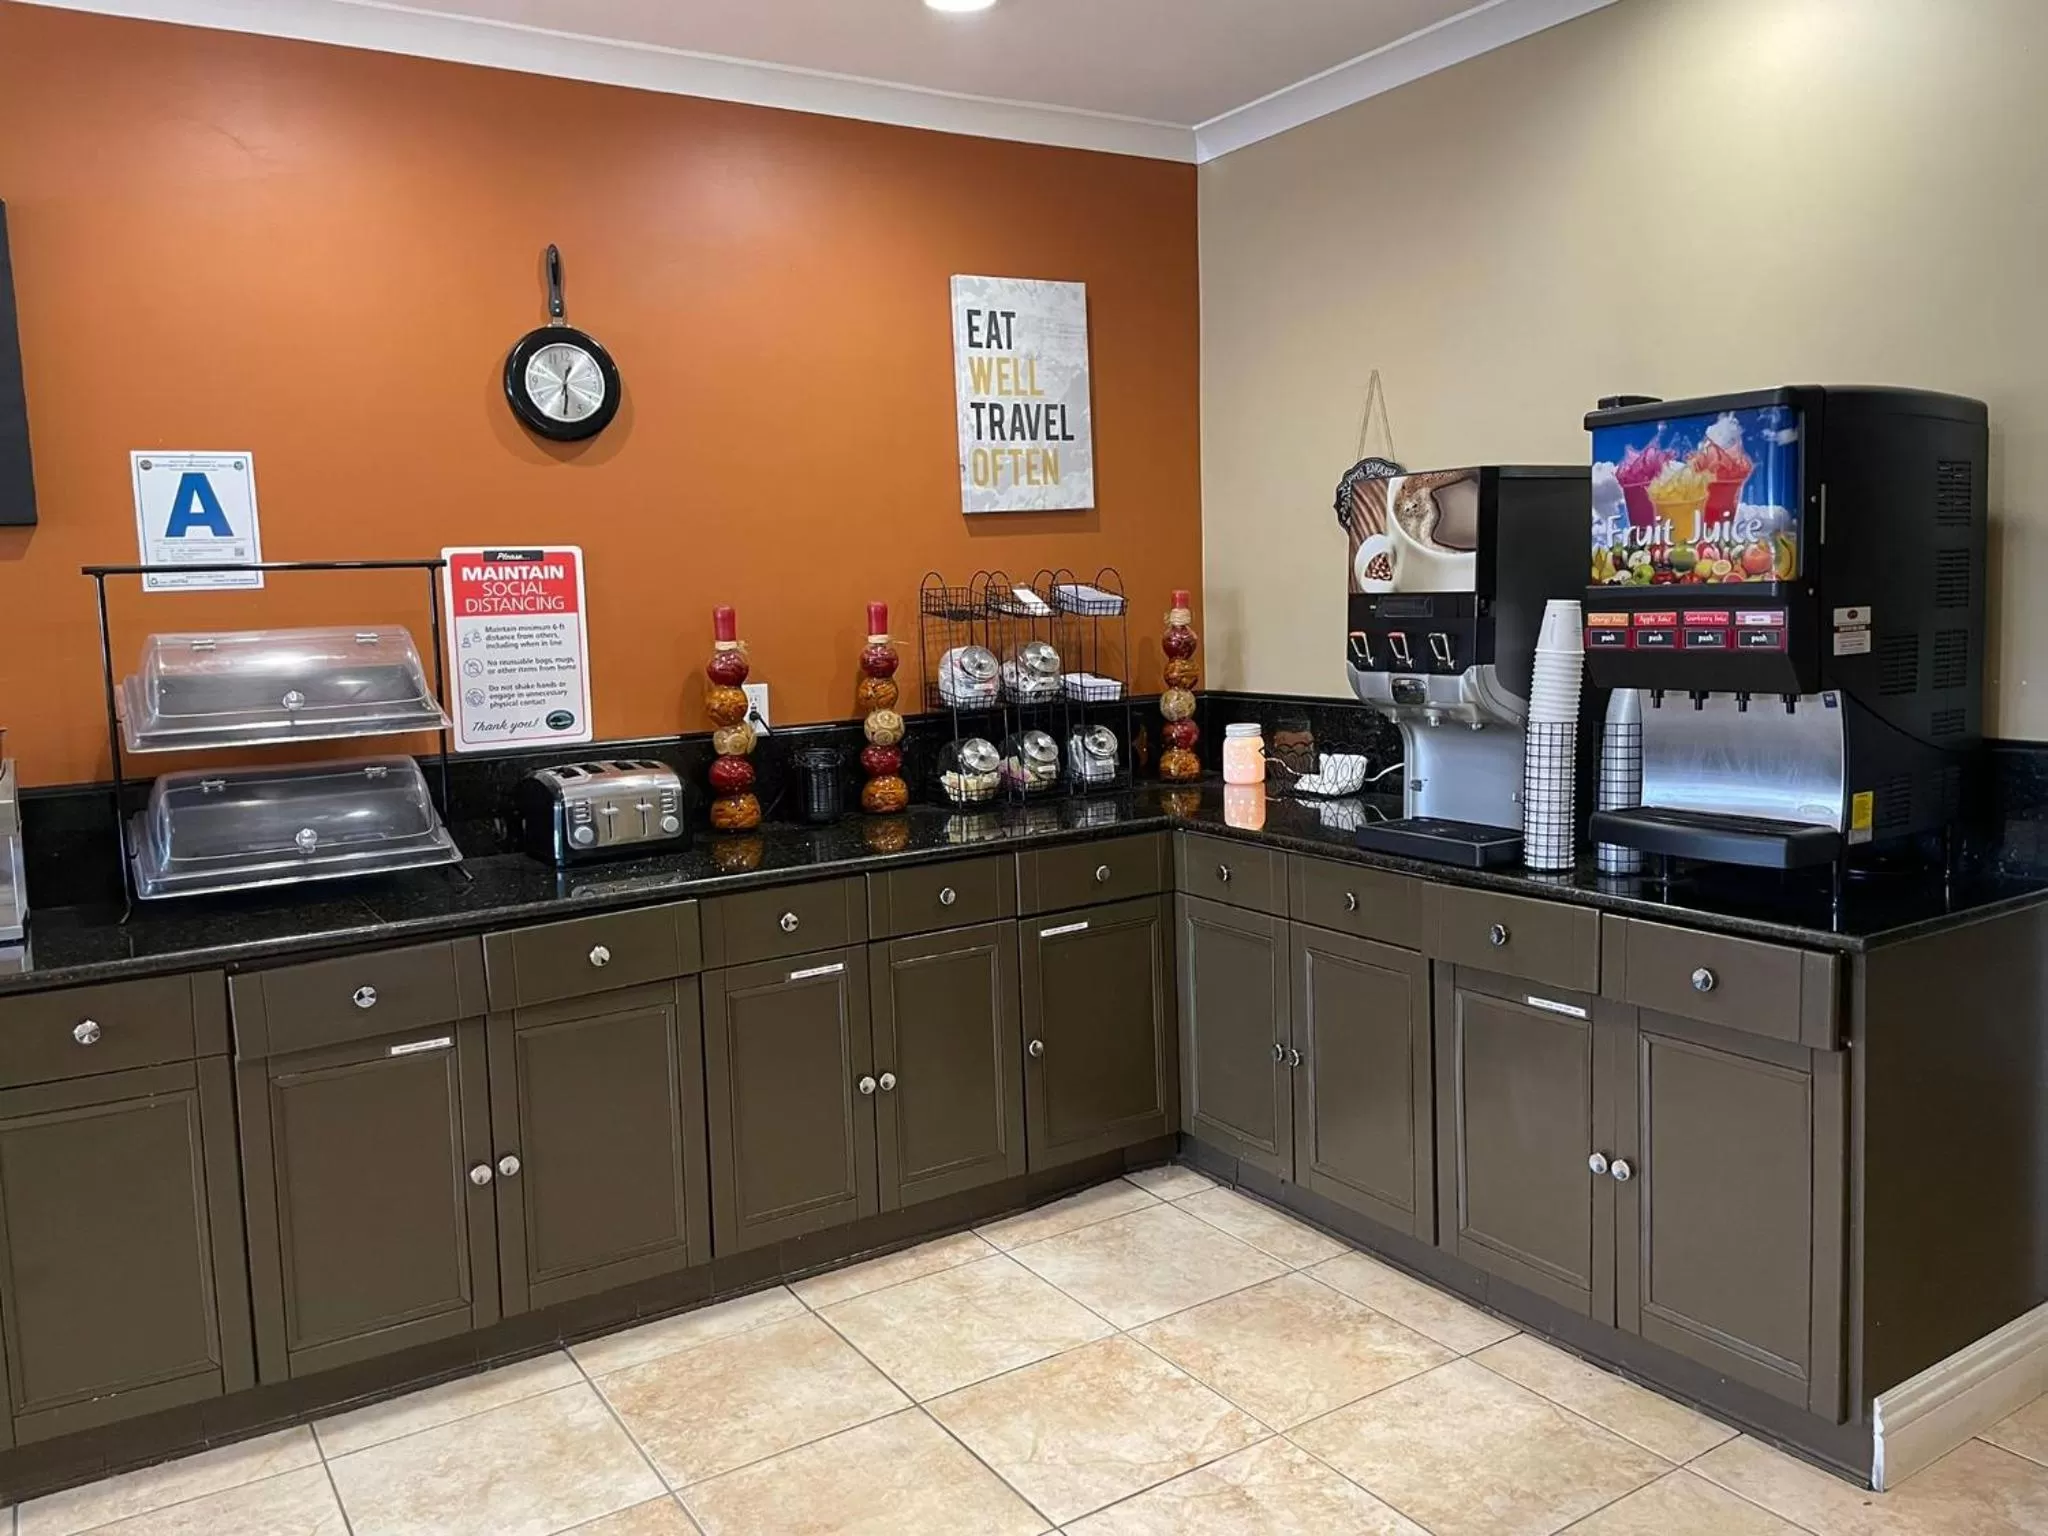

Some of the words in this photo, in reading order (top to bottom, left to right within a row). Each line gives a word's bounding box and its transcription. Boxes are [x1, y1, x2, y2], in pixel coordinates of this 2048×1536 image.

[966, 309, 1016, 350] EAT
[561, 350, 570, 361] 12
[968, 356, 1045, 396] WELL
[970, 401, 1075, 441] TRAVEL
[972, 448, 1060, 486] OFTEN
[165, 472, 234, 537] A
[1606, 514, 1675, 548] Fruit
[1687, 509, 1762, 544] Juice
[462, 565, 564, 581] MAINTAIN
[482, 581, 547, 597] SOCIAL
[465, 595, 565, 613] DISTANCING
[1639, 614, 1655, 625] Apple
[1657, 614, 1672, 622] Juice
[1685, 614, 1713, 623] Cranberry
[1714, 613, 1727, 622] Juice
[1601, 633, 1616, 643] push
[1648, 633, 1663, 643] push
[1698, 633, 1714, 643] push
[1751, 633, 1768, 644] push
[486, 641, 519, 649] including
[501, 683, 513, 691] not
[536, 680, 557, 688] hands
[526, 689, 568, 697] unnecessary
[490, 699, 518, 709] physical
[520, 698, 546, 706] contact
[471, 719, 508, 732] Thank
[510, 717, 540, 734] you!
